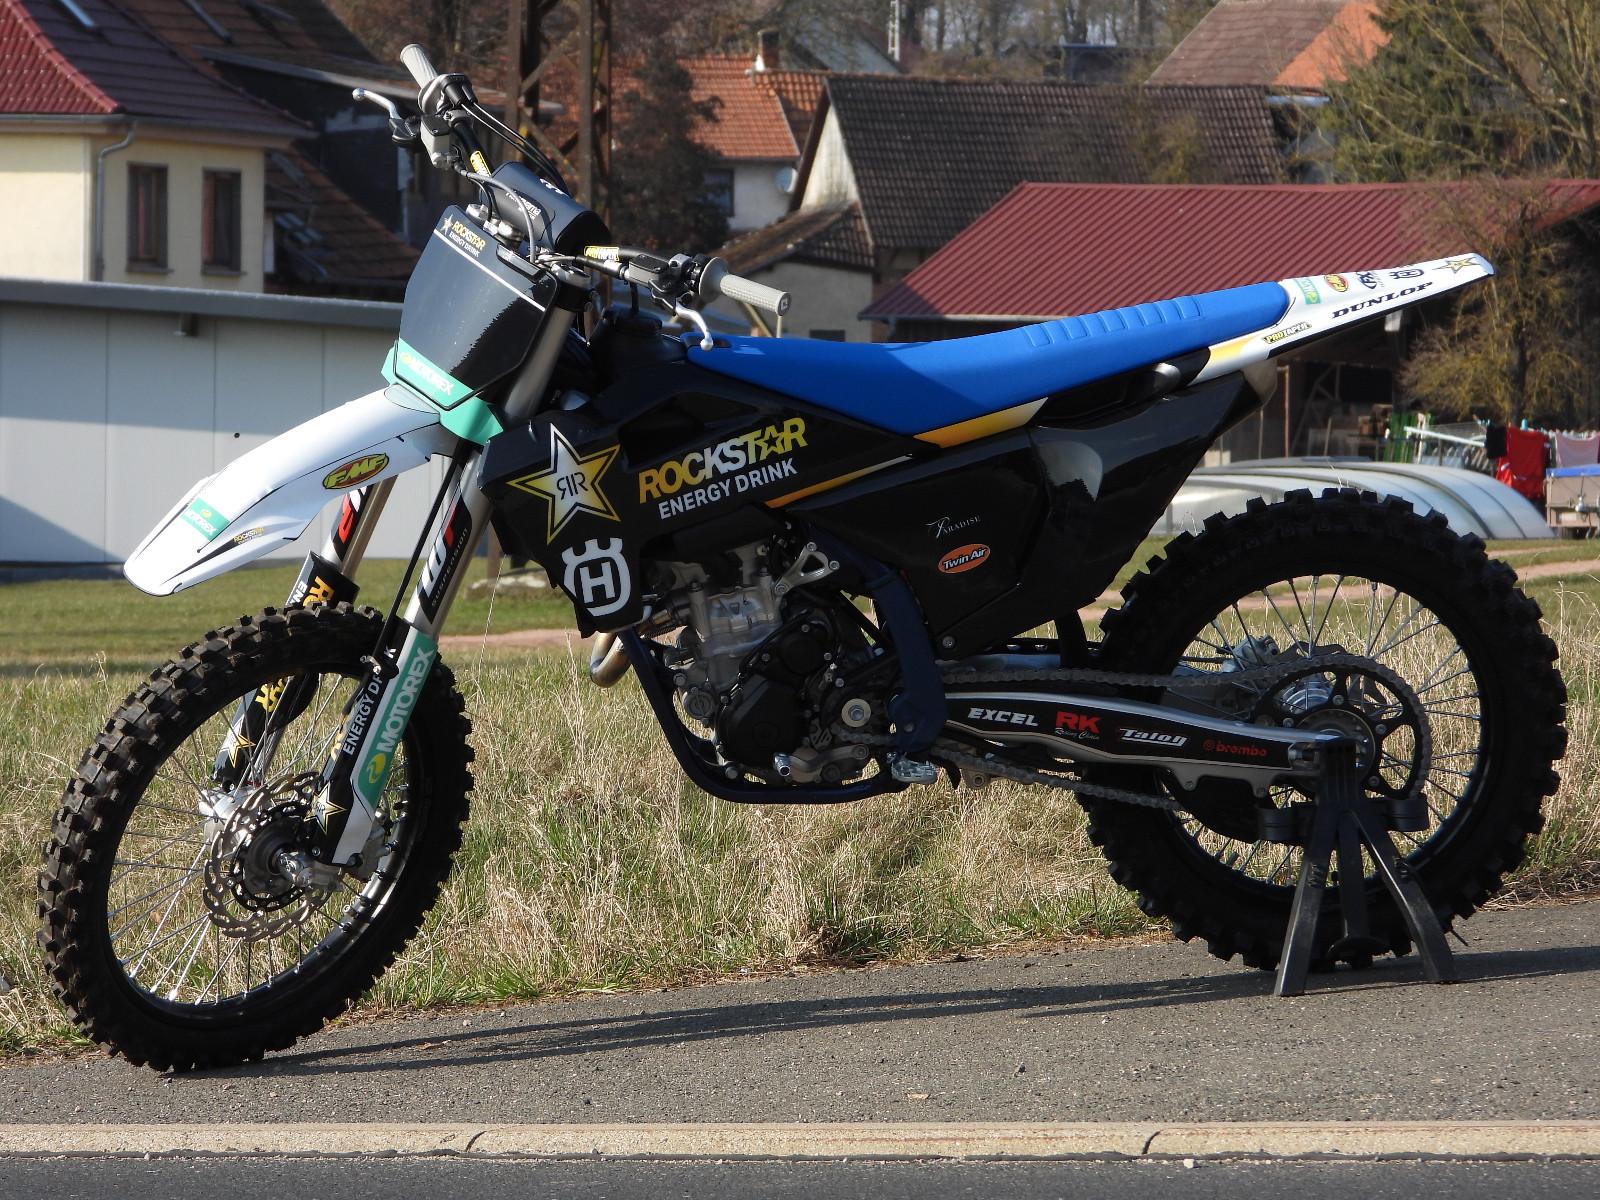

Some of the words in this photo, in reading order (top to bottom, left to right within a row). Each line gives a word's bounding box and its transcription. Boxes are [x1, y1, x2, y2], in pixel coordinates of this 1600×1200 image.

[452, 221, 486, 250] ROCKSTAR
[1332, 281, 1433, 319] DUNLOP
[324, 453, 389, 489] FMF
[639, 417, 808, 505] ROCKSTAR
[658, 480, 732, 520] ENERGY
[735, 458, 798, 493] DRINK
[943, 554, 969, 570] Twin
[970, 548, 987, 561] Air
[376, 647, 434, 753] MOTOREX
[343, 692, 376, 756] ENERGY
[967, 707, 1039, 727] EXCEL
[1055, 711, 1101, 734] RK
[1119, 728, 1190, 748] Talon
[1215, 741, 1268, 757] brembo
